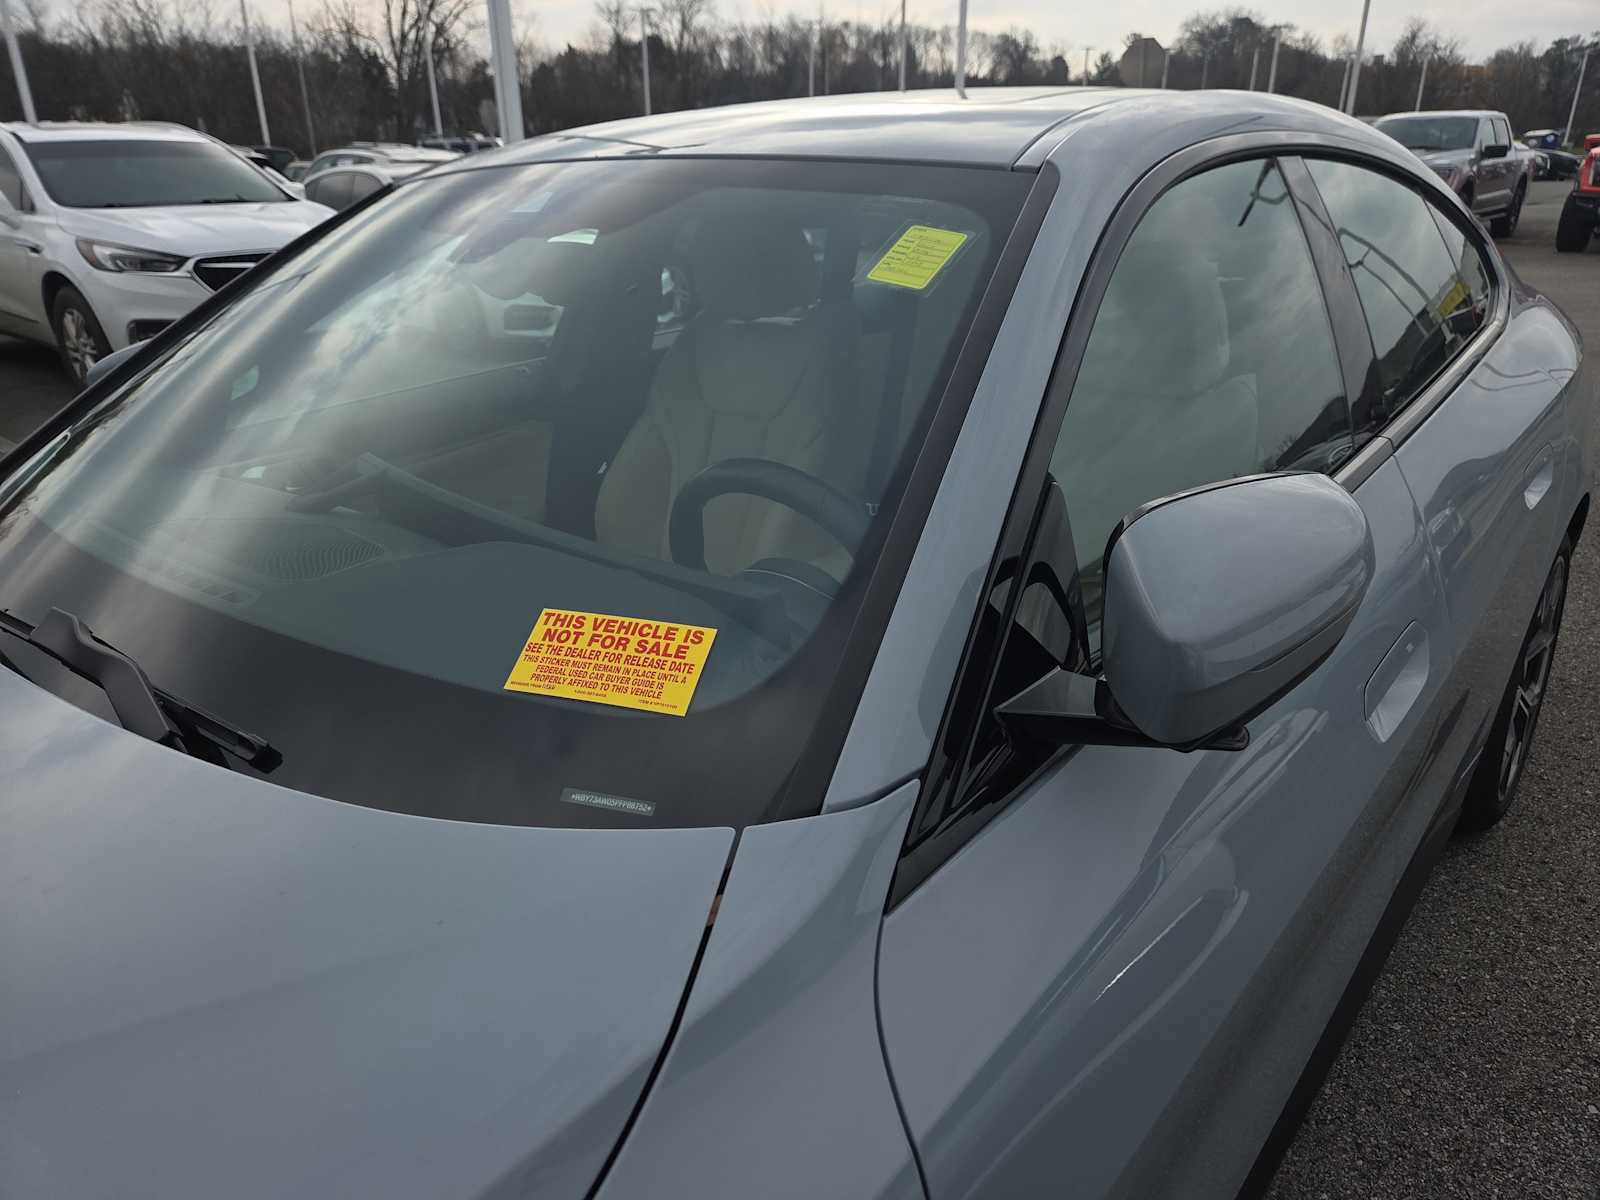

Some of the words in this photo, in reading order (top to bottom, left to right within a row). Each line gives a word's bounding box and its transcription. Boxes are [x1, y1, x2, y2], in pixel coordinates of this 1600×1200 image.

[542, 612, 586, 630] THIS
[592, 617, 678, 641] VEHICLE
[684, 630, 704, 645] IS
[542, 628, 584, 644] NOT
[587, 635, 629, 653] FOR
[634, 640, 689, 659] SALE
[524, 655, 539, 663] THIS
[540, 657, 570, 668] STICKER
[571, 660, 592, 670] MUST
[593, 663, 621, 674] REMAIN
[622, 667, 632, 675] IN
[633, 668, 656, 678] PLACE
[657, 672, 680, 683] UNTIL
[680, 676, 687, 684] A
[525, 642, 542, 653] SEE
[545, 644, 564, 656] THE
[565, 647, 602, 661] DEALER
[603, 652, 625, 664] FOR
[624, 656, 667, 670] RELEASE
[670, 661, 695, 674] DATE
[531, 673, 568, 685] PROPERLY
[568, 678, 598, 689] AFFIXED
[612, 684, 630, 694] THIS
[631, 687, 662, 699] VEHICLE
[536, 665, 567, 677] FEDERAL
[567, 670, 588, 679] USED
[589, 672, 607, 681] CAR
[607, 675, 632, 686] BUYER
[632, 678, 656, 688] GUIDE
[656, 682, 664, 690] IS
